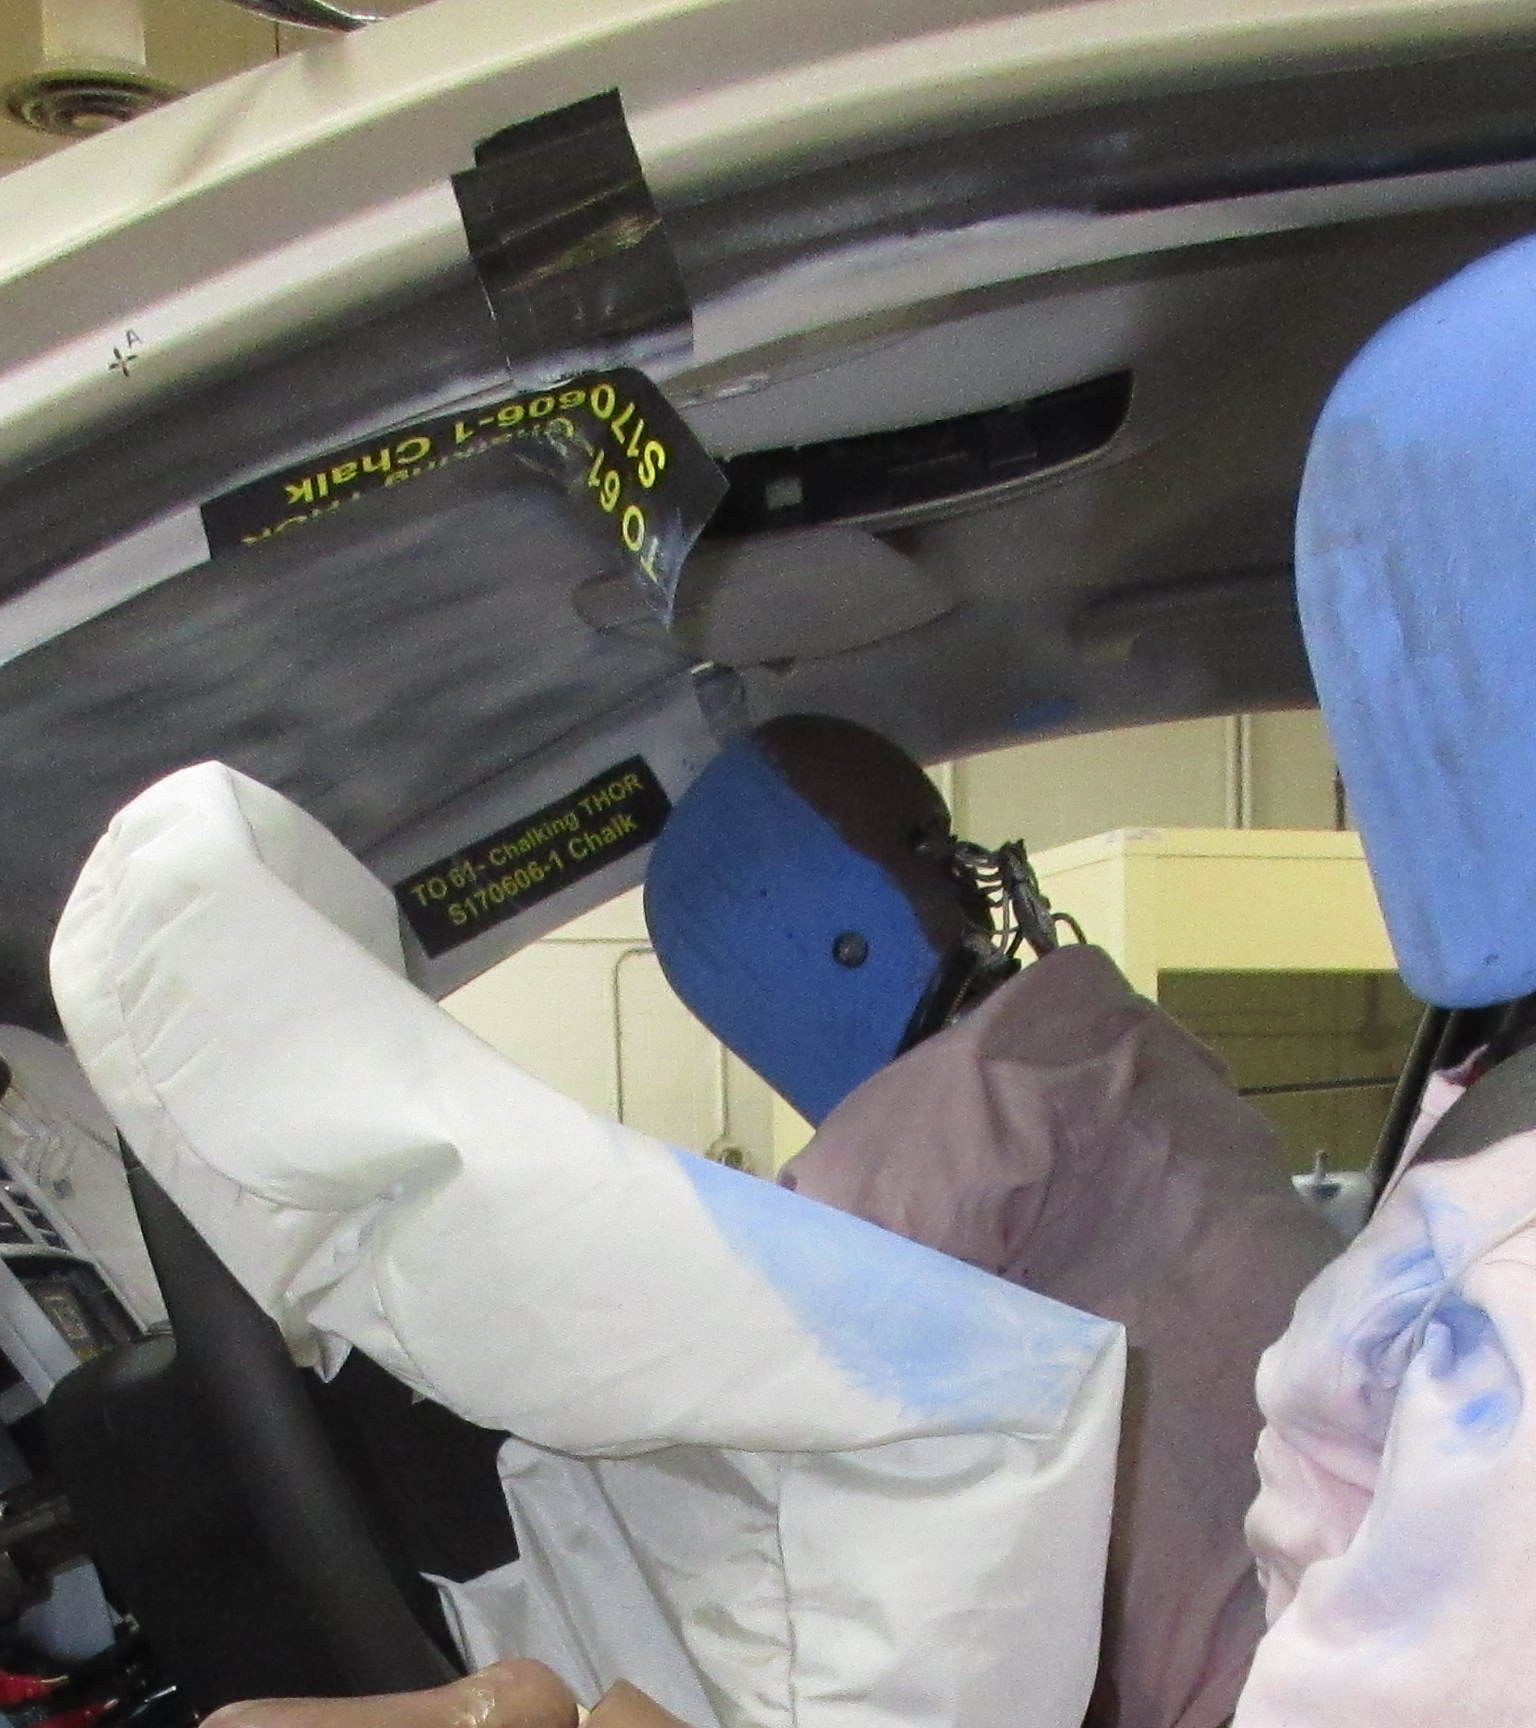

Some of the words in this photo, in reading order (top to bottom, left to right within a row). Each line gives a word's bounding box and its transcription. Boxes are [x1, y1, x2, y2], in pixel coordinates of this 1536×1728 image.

[285, 436, 431, 503] Chalk
[412, 877, 448, 907] TO
[488, 812, 580, 866] Chalking
[578, 773, 643, 816] THOR
[447, 850, 564, 926] S170606-1
[568, 813, 638, 859] Chalk
